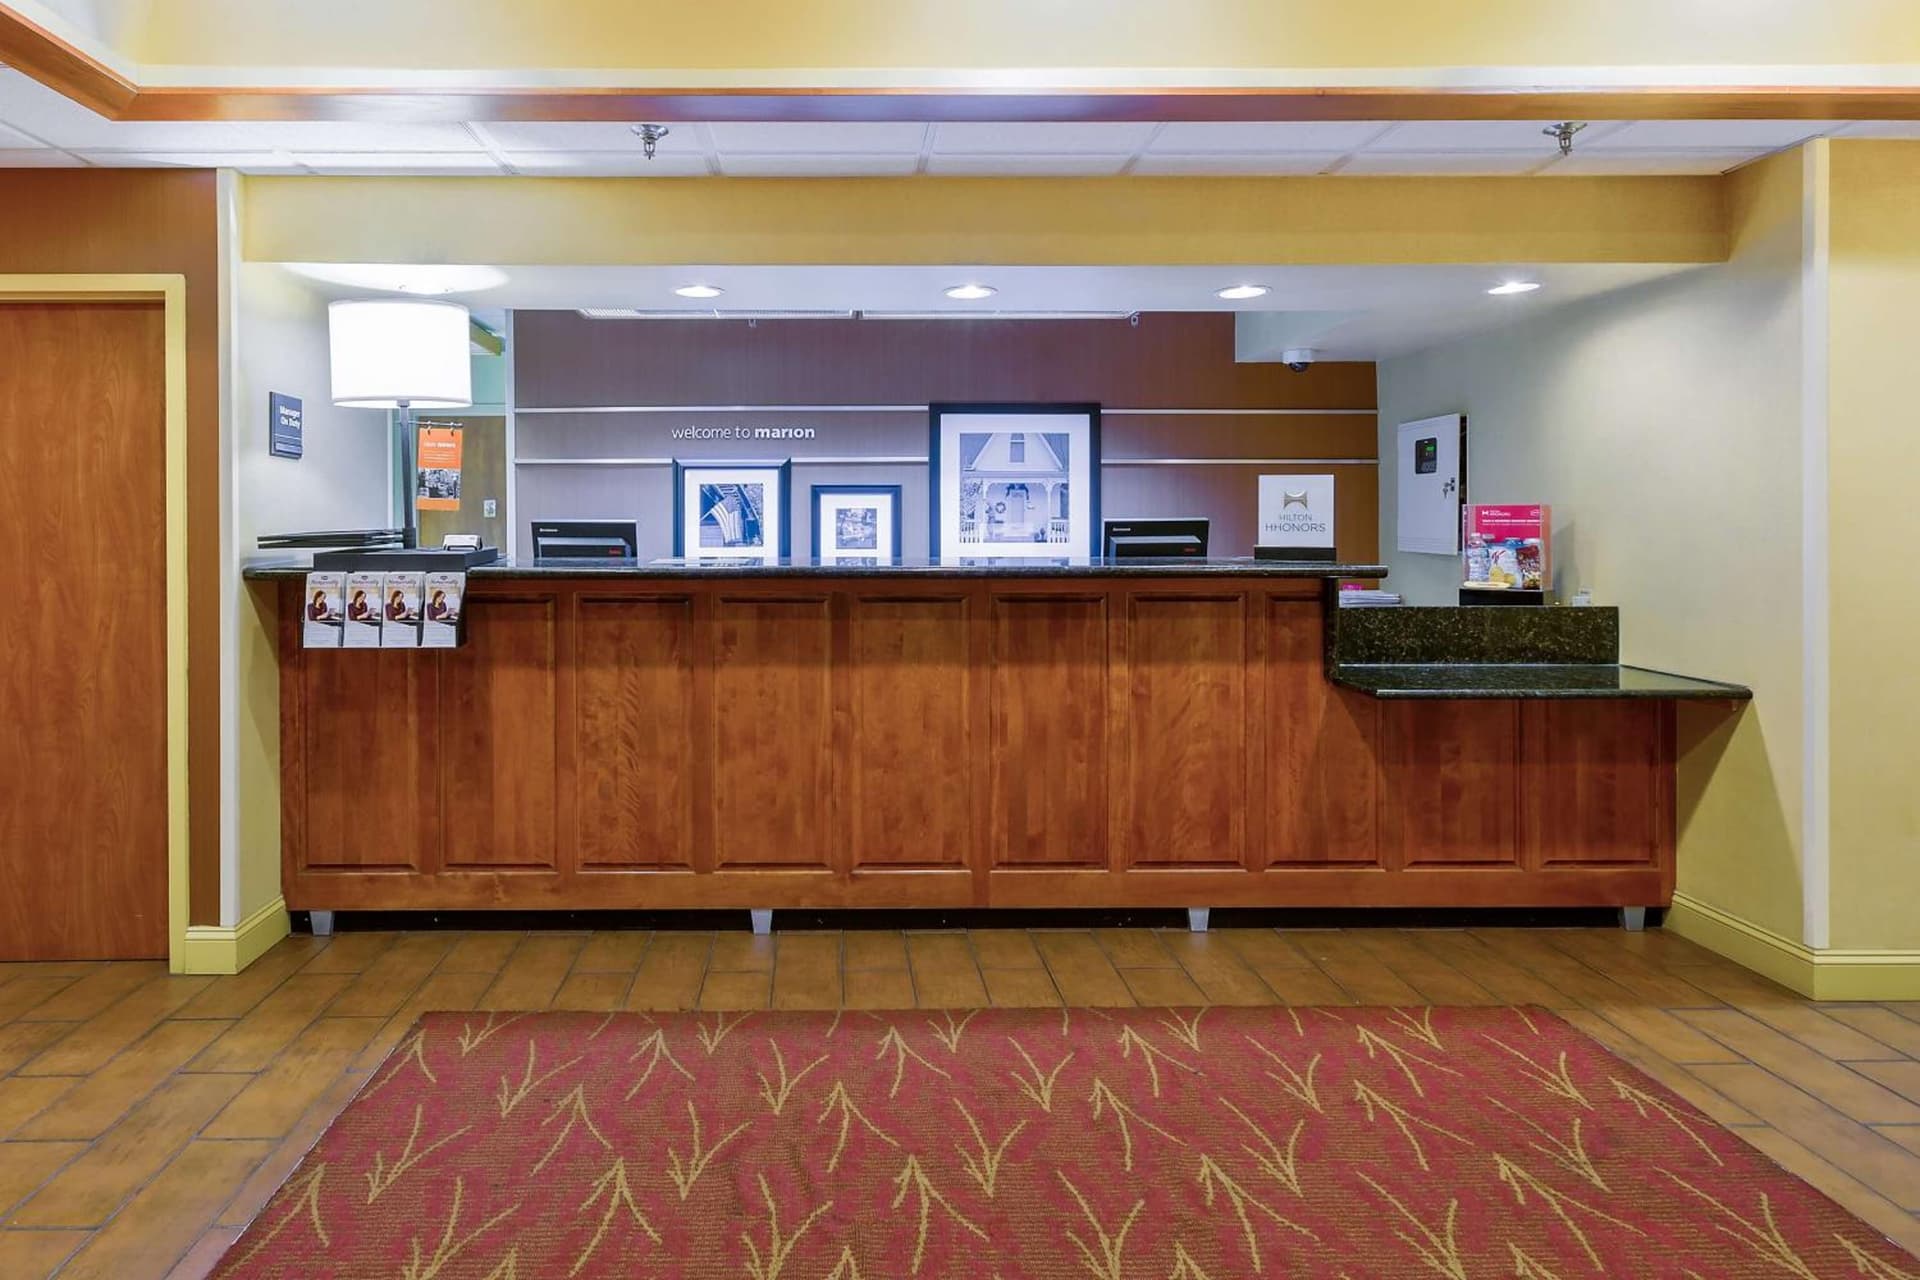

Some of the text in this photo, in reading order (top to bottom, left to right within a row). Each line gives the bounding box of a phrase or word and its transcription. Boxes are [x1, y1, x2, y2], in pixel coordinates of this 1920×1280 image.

[279, 405, 300, 419] Manager
[280, 416, 300, 430] On Duty
[672, 426, 815, 439] welcome to marion
[1279, 513, 1312, 522] HILTON
[1265, 523, 1326, 532] HHONORS
